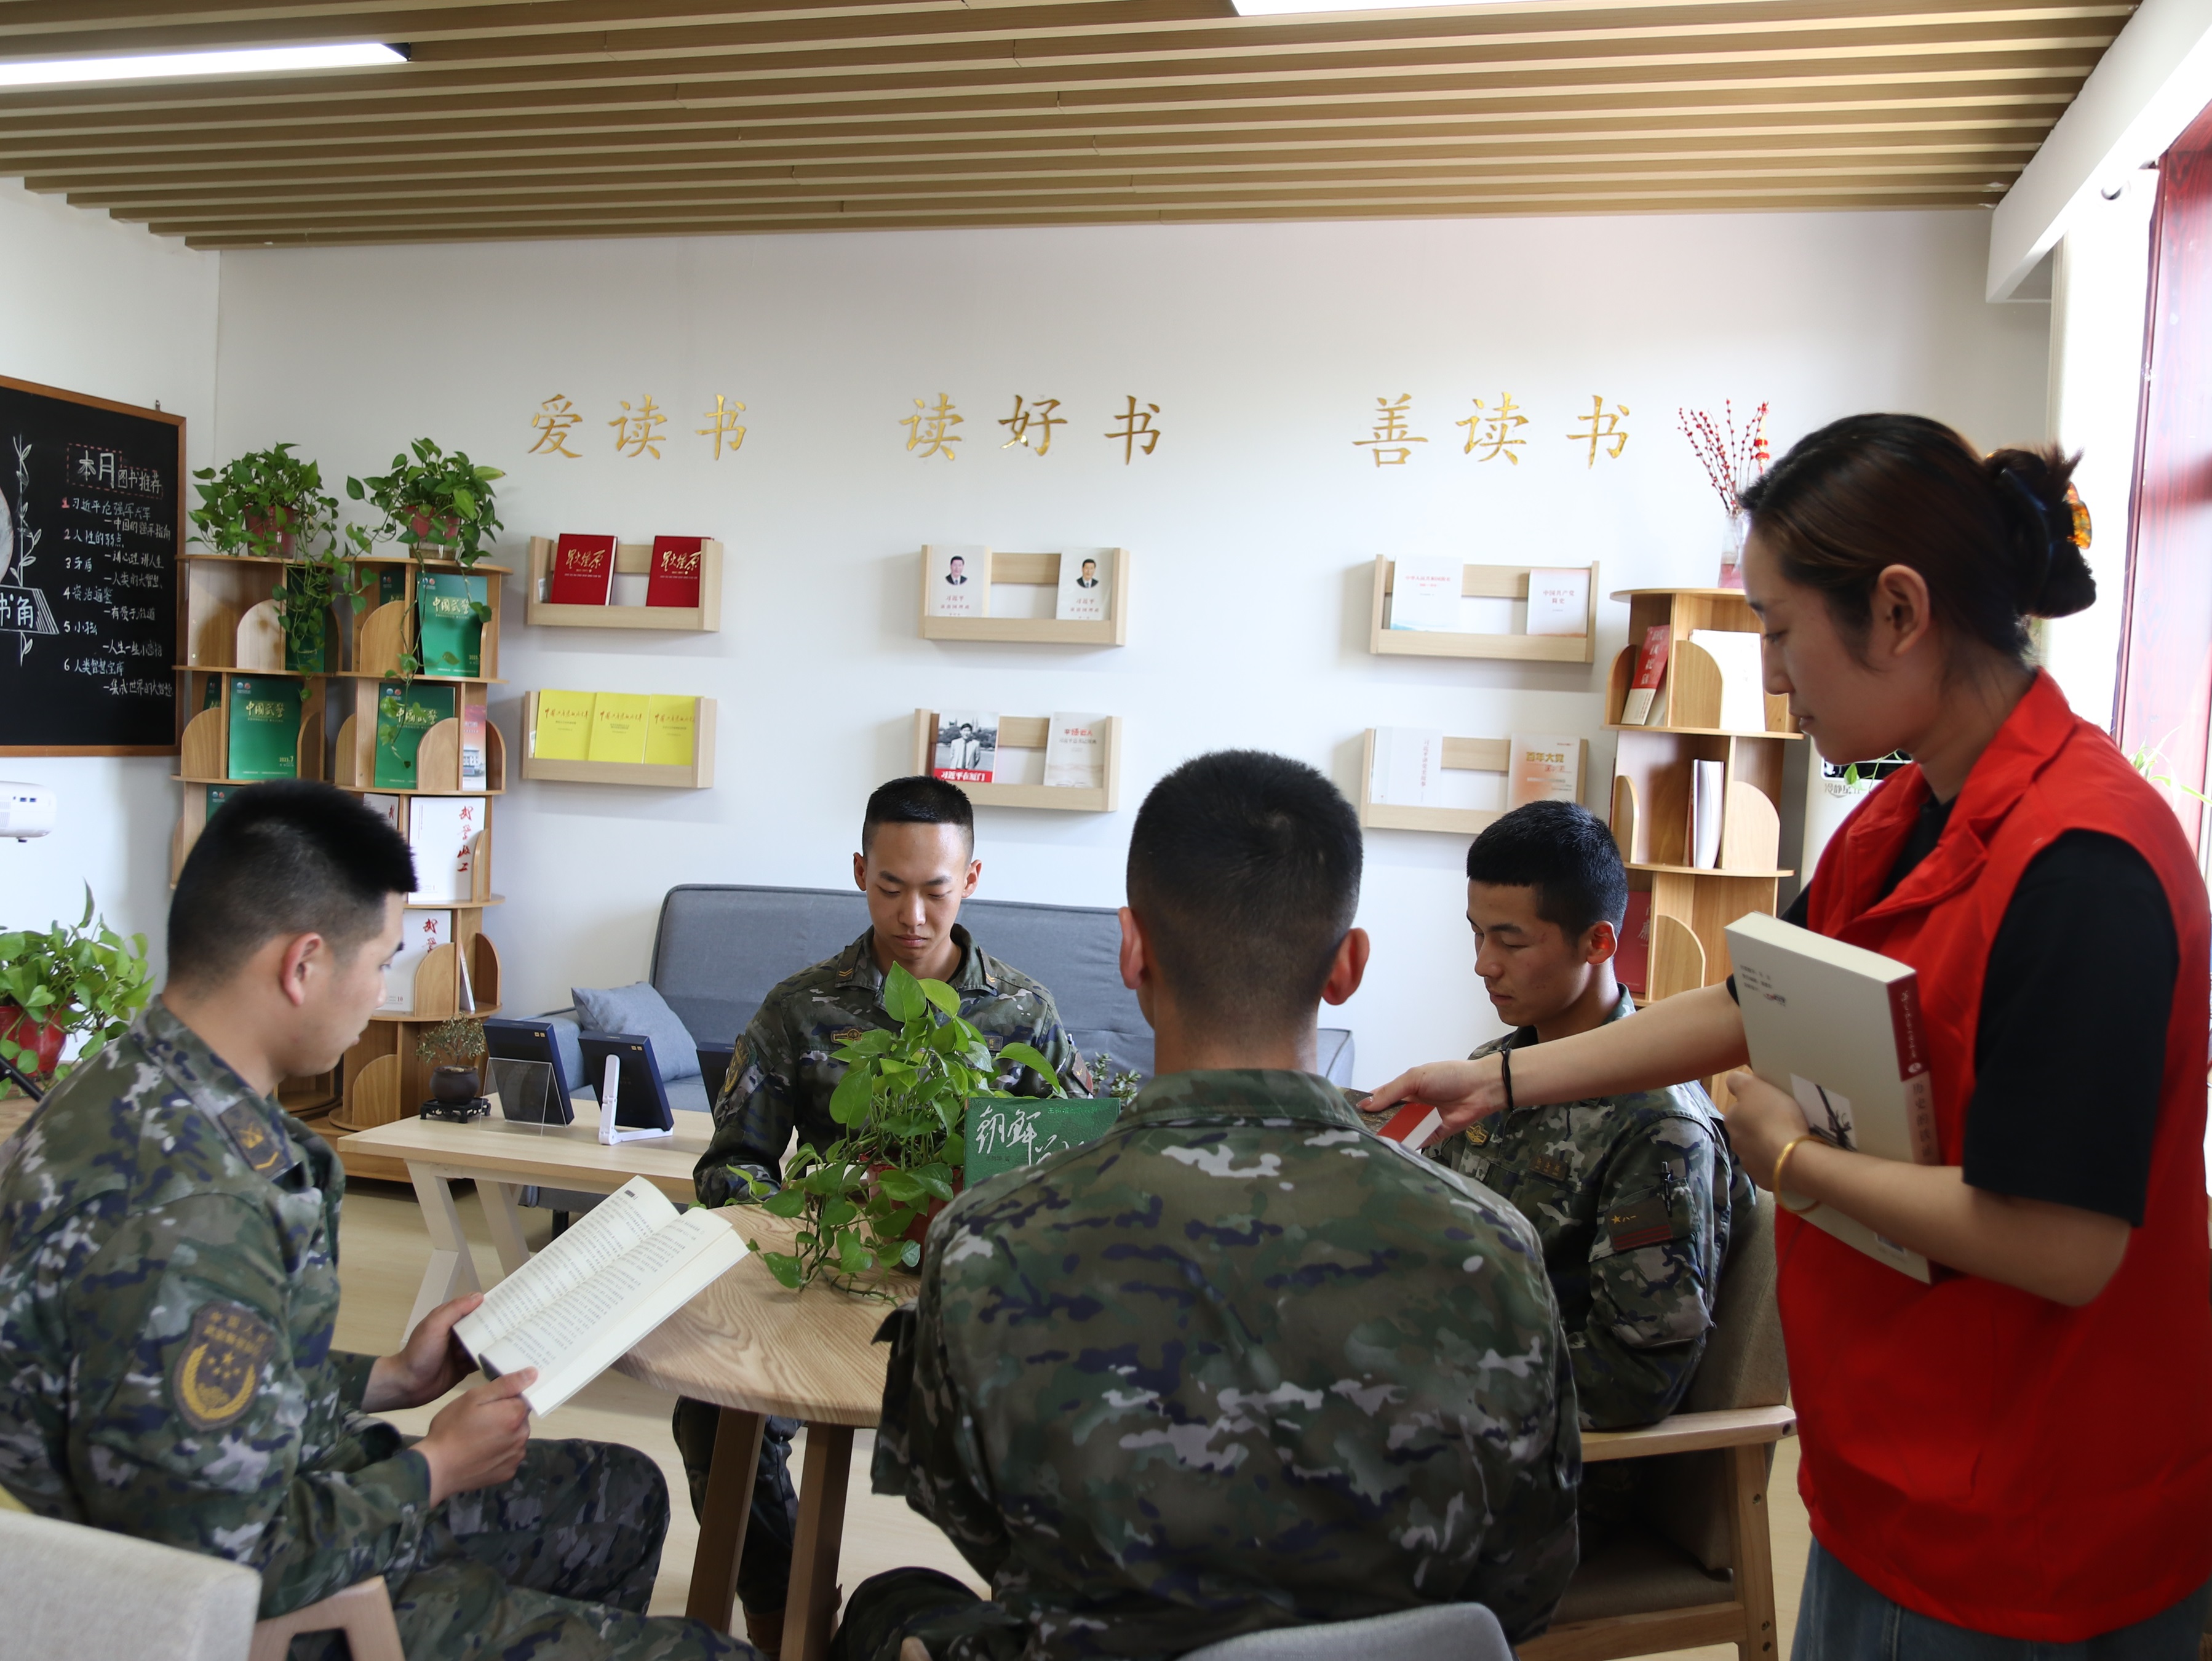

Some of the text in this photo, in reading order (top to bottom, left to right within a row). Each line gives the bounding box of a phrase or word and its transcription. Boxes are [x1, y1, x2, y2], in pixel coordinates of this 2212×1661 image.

[528, 392, 1629, 469] 爱读书 读好书 善读书
[1526, 752, 1564, 763] 百年大党
[941, 771, 985, 782] 习近平在厦门
